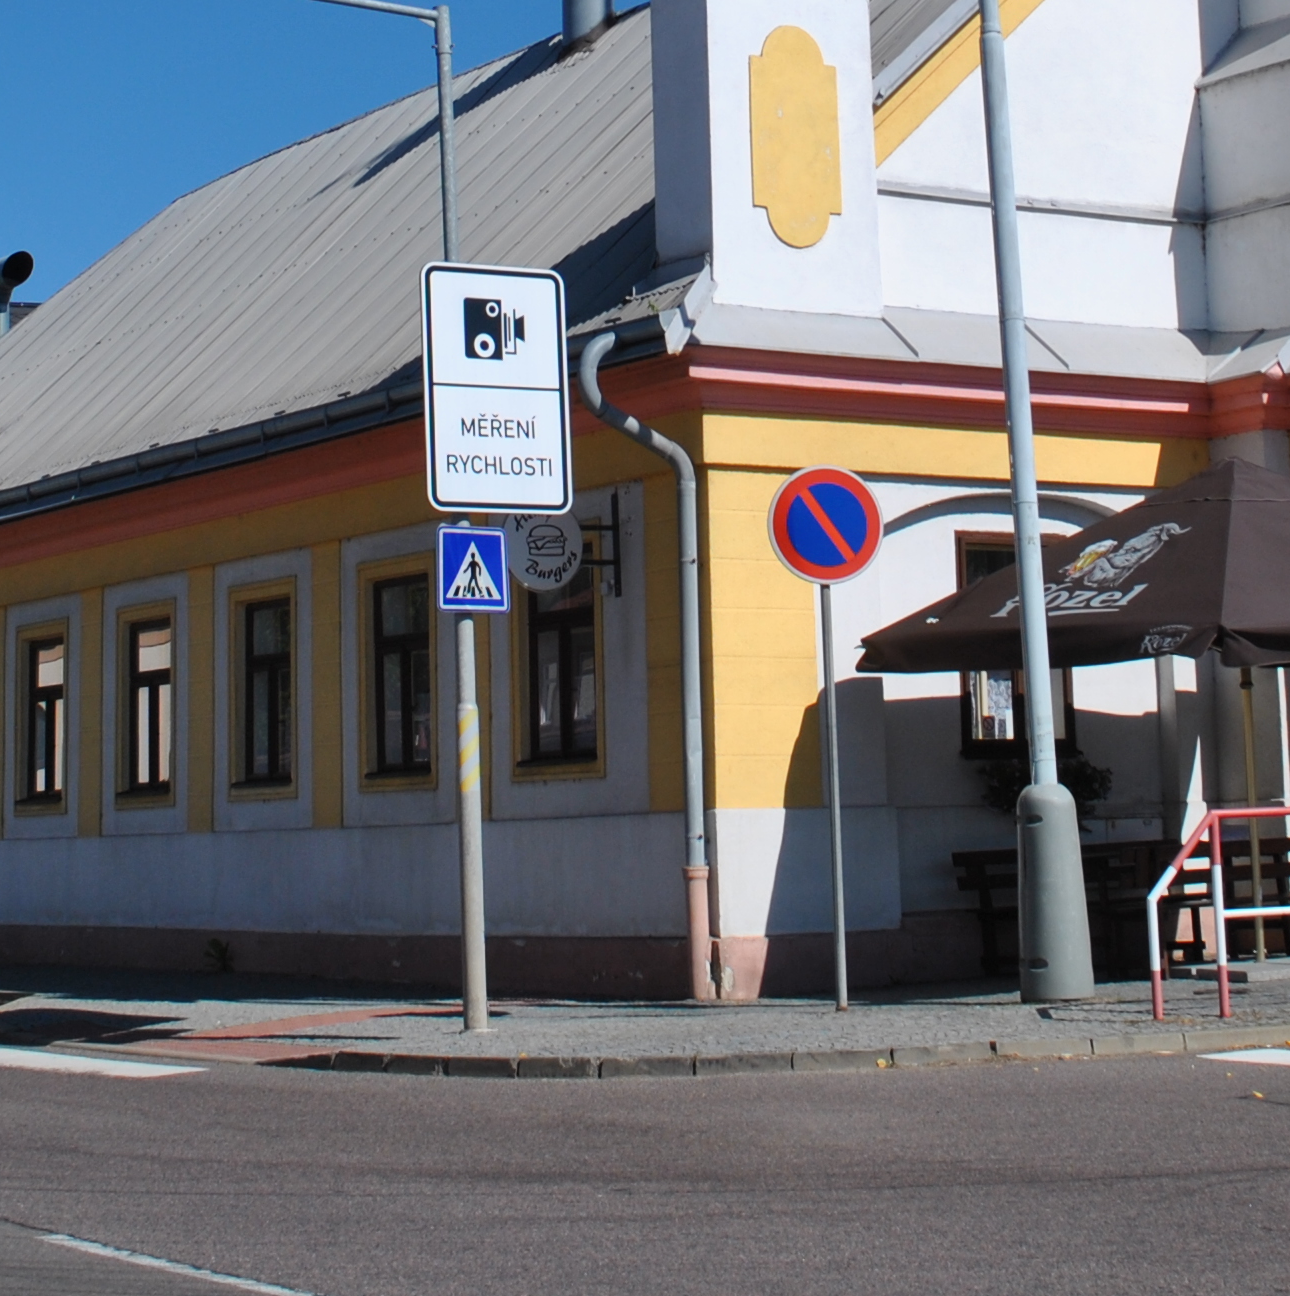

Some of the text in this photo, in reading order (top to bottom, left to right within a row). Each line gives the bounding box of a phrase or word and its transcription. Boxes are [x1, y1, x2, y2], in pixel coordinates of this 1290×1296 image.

[460, 413, 537, 440] MĚŘENÍ
[446, 454, 553, 477] RYCHLOSTI
[525, 550, 578, 584] Burgers
